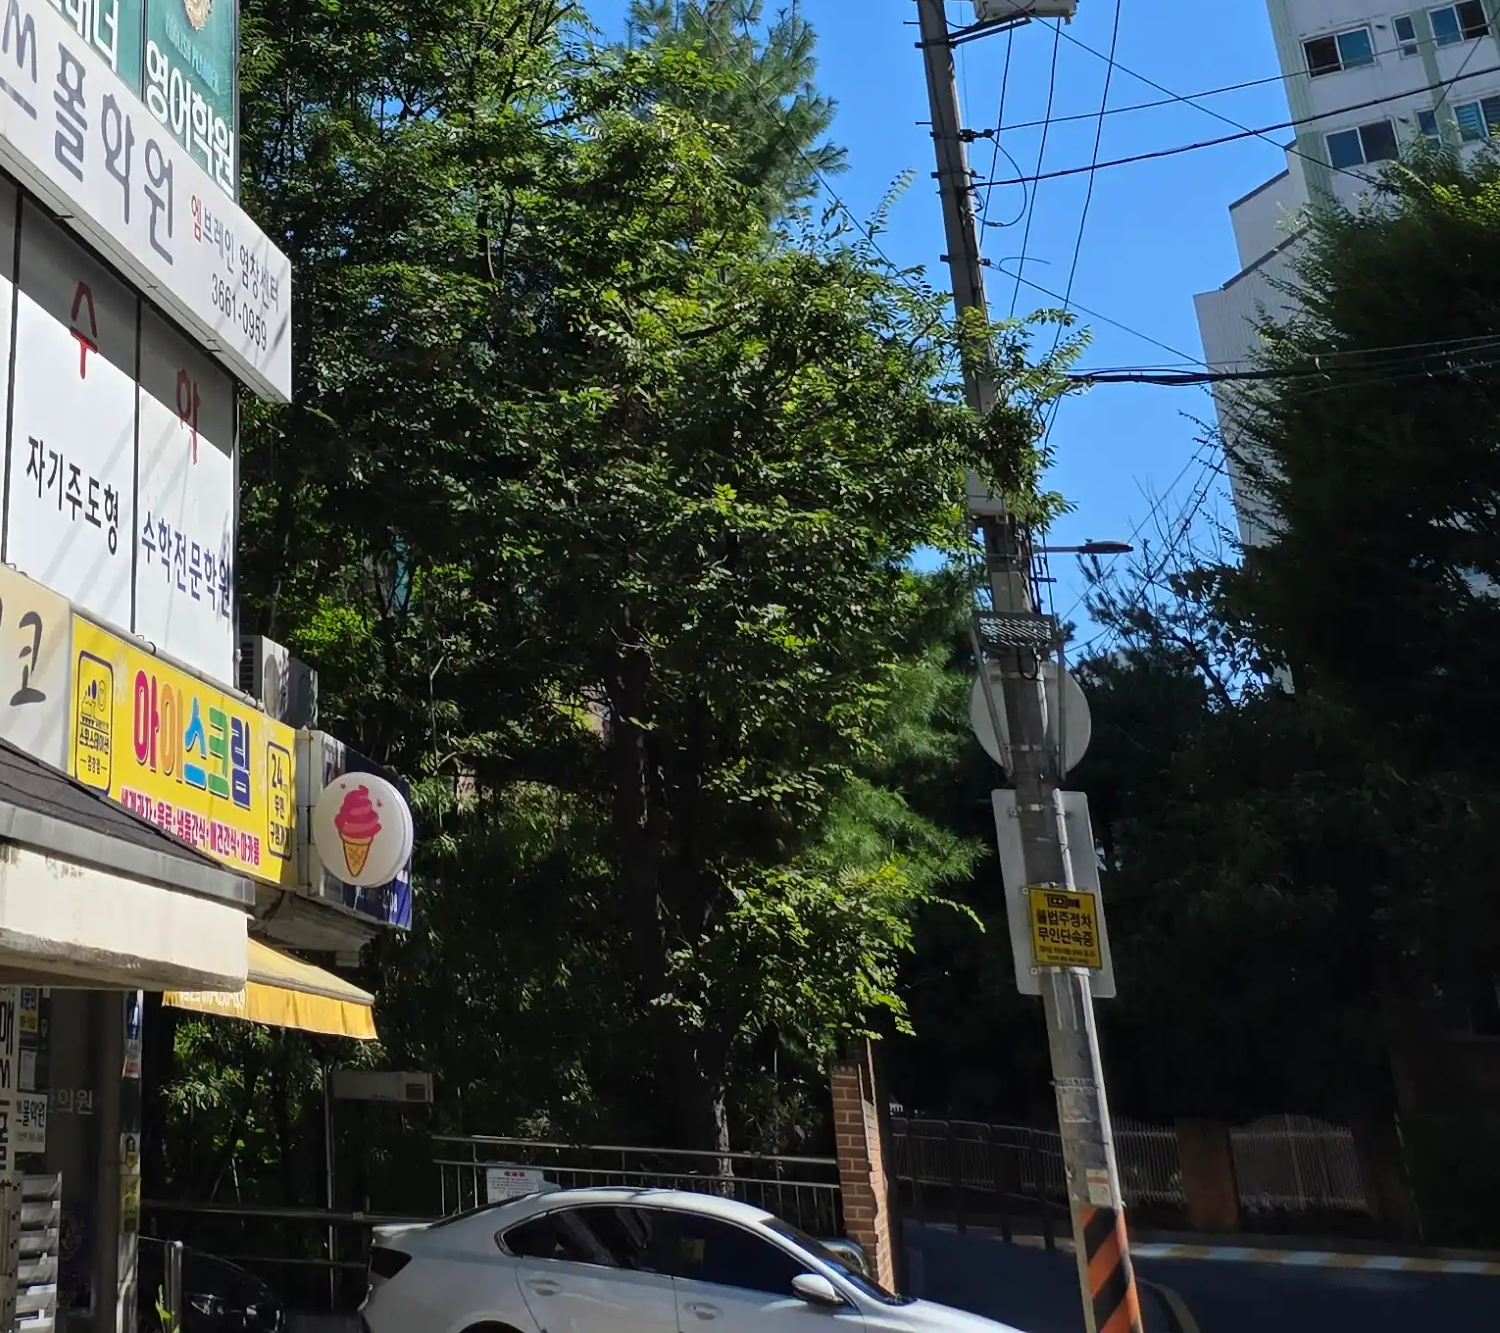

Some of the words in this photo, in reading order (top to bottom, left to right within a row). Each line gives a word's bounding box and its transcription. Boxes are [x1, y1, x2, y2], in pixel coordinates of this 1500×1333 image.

[146, 39, 235, 198] 영어학원
[190, 194, 235, 275] 엠브레인
[239, 243, 280, 314] 염창센터
[211, 273, 268, 351] 3661-0959
[25, 435, 120, 556] 자기주도형
[141, 510, 232, 619] 수학전문학원
[133, 669, 251, 811] 아이스크림
[1038, 926, 1095, 948] 무인단속중
